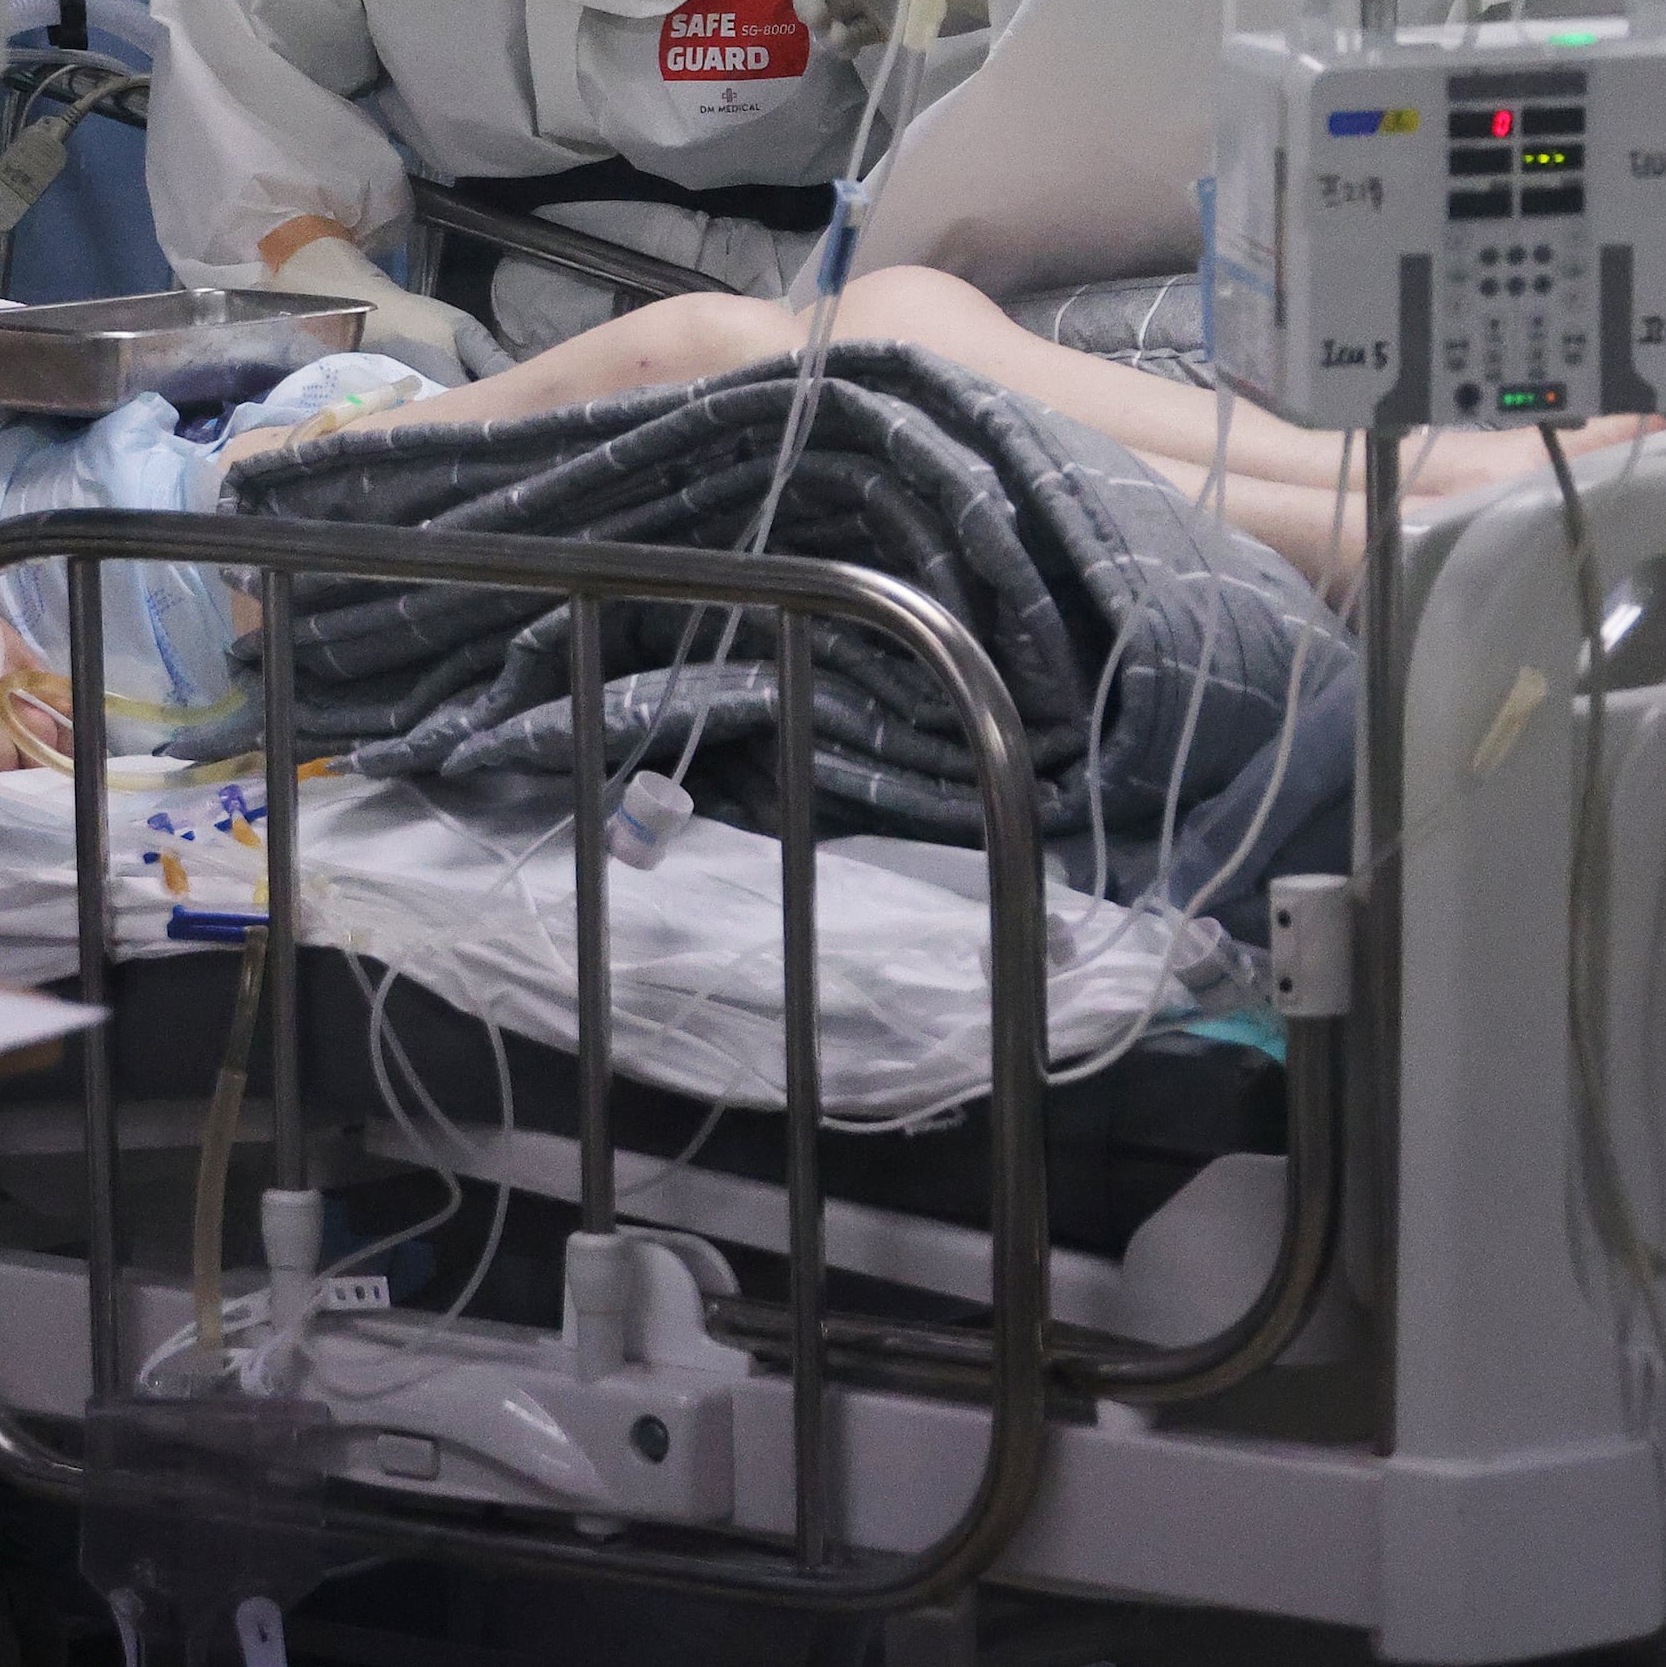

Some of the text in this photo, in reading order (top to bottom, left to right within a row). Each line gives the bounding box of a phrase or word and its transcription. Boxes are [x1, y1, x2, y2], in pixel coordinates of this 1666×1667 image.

[670, 12, 796, 38] SAFE SG-8000
[666, 45, 770, 72] GUARD
[699, 103, 761, 114] DM MEDICAL
